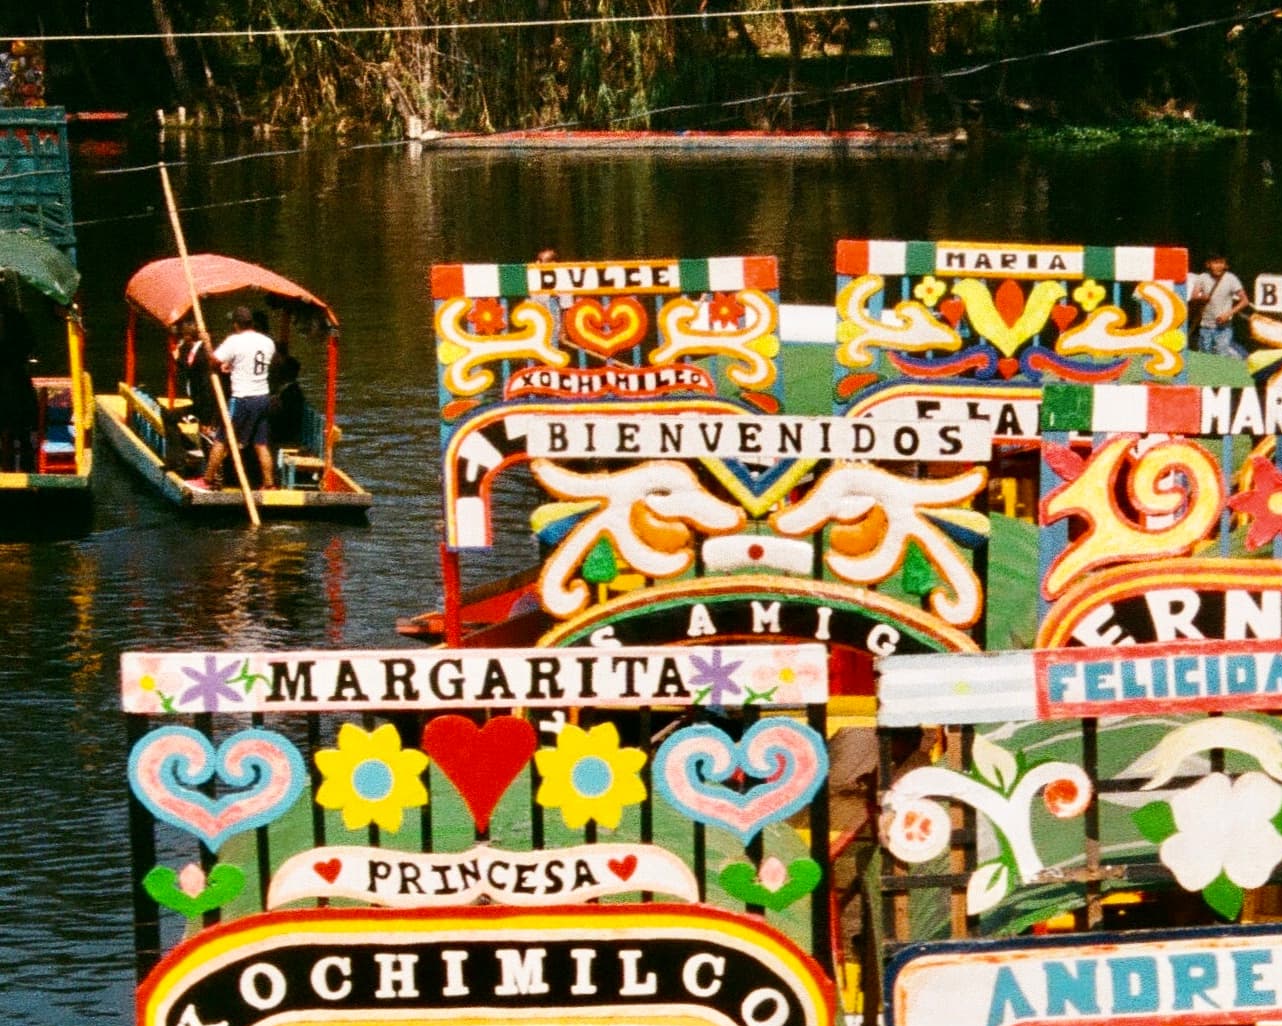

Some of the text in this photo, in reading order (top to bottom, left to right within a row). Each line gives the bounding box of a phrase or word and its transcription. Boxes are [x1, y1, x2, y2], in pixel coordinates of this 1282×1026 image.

[946, 252, 1067, 270] MARIA
[547, 422, 963, 456] BIENVENIDOS
[265, 656, 692, 703] MARGARITA
[367, 859, 601, 896] PRINCESA
